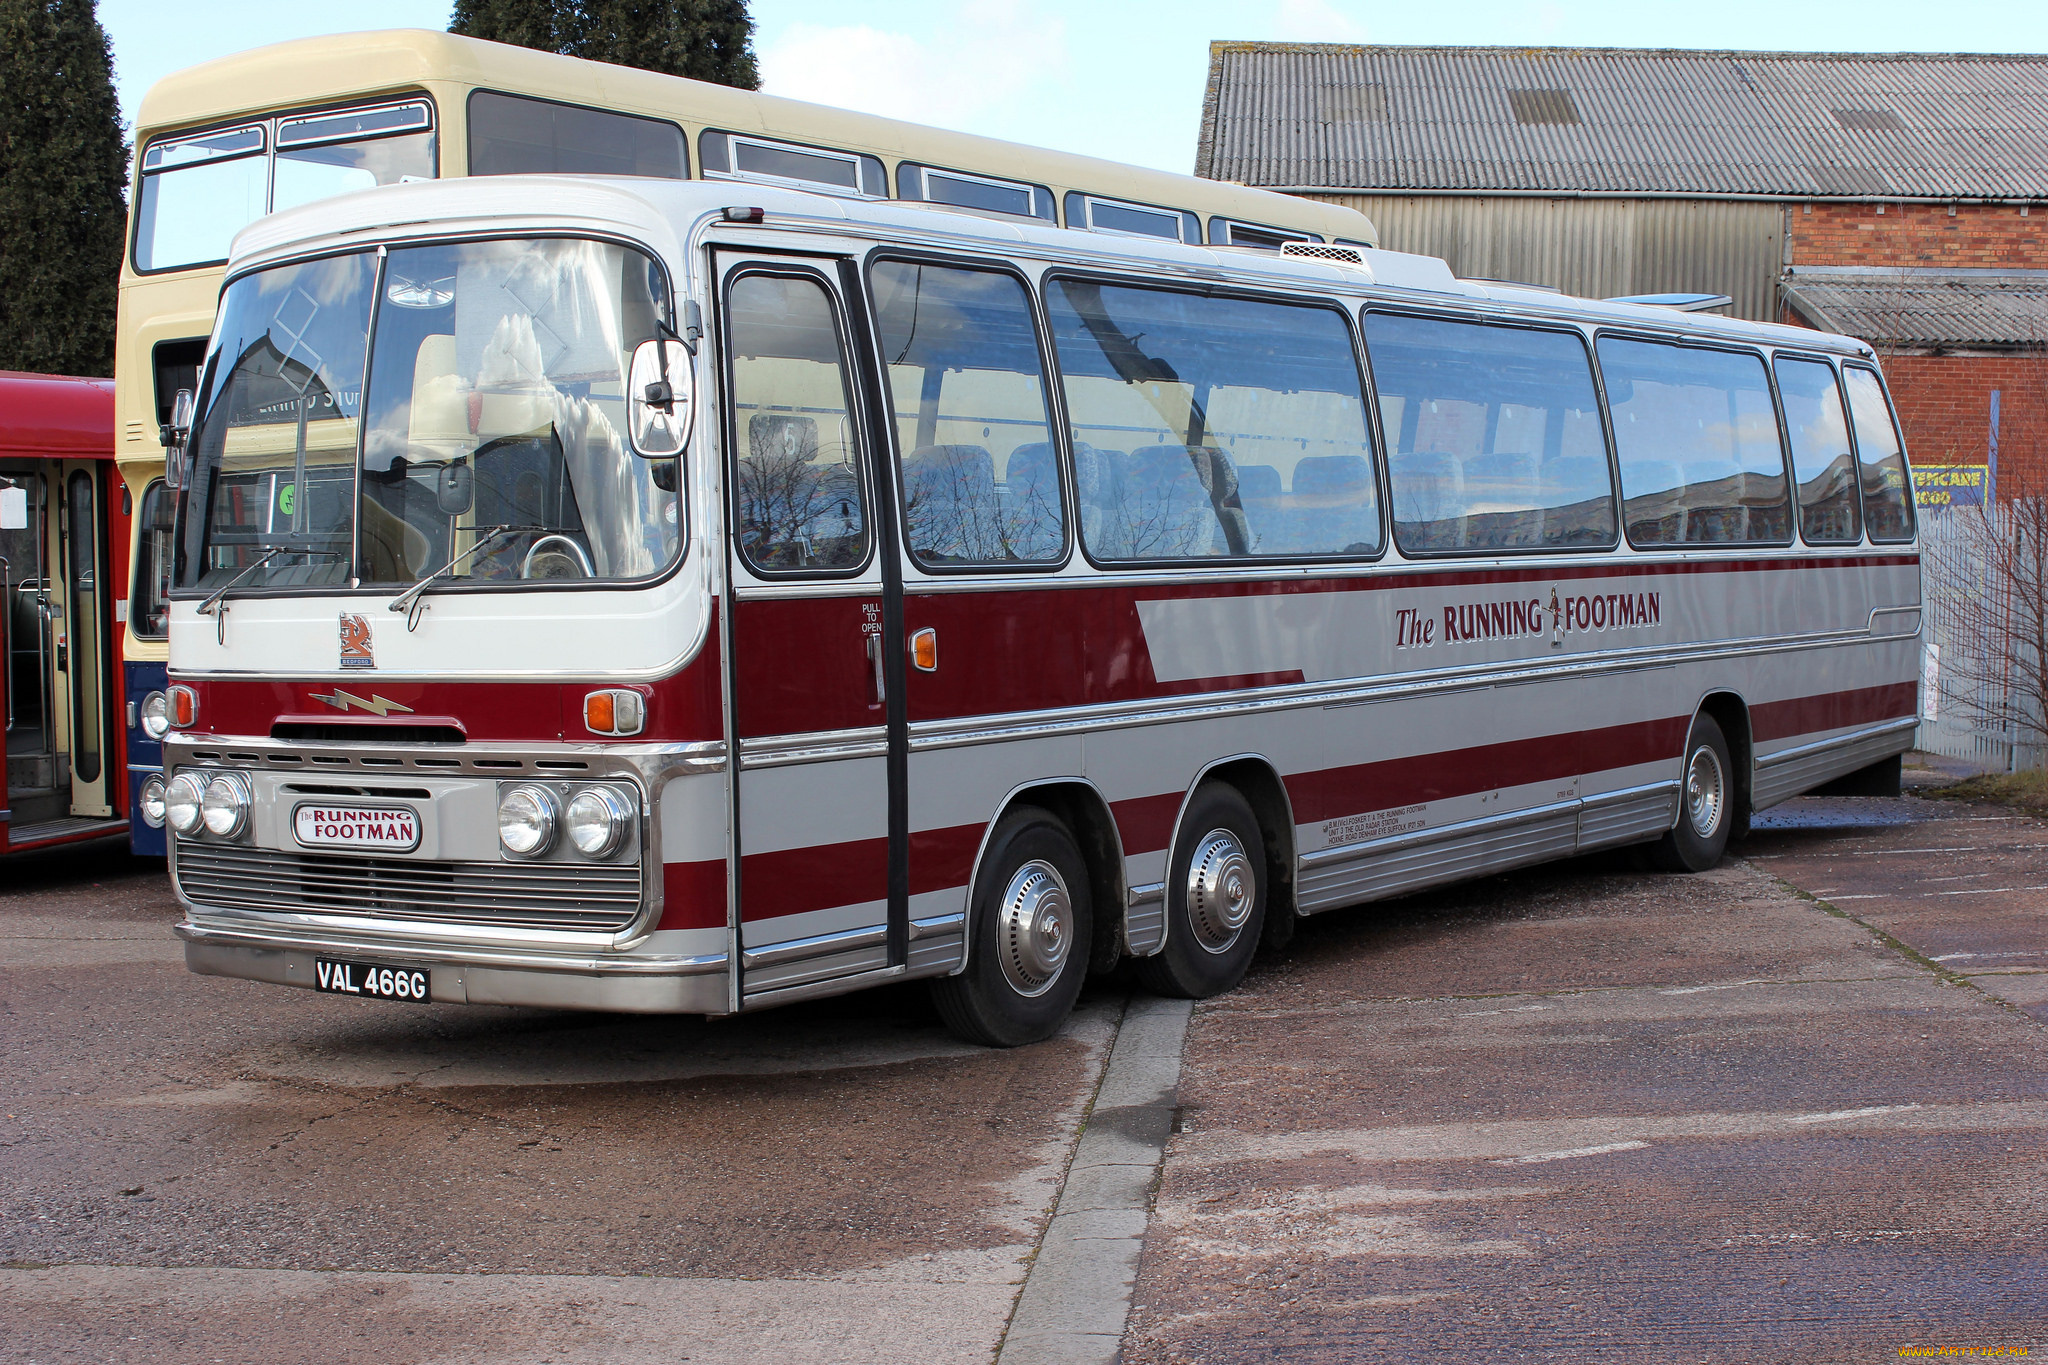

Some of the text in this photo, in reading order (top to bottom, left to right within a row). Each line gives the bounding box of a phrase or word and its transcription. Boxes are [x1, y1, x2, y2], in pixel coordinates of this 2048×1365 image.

[784, 423, 796, 455] 5
[862, 602, 881, 613] PULL
[866, 613, 877, 622] TO
[1396, 592, 1661, 648] The RUNNING FOOTMAN
[861, 622, 882, 632] OPEN
[300, 810, 411, 822] The RUNNING
[1387, 808, 1405, 817] RUNNING
[1407, 804, 1426, 814] FOOTMAN
[315, 823, 413, 840] FOOTMAN
[1329, 828, 1339, 837] UNIT
[1345, 825, 1354, 833] THE
[1355, 824, 1364, 832] OLD
[1366, 820, 1380, 829] RADAR
[1381, 817, 1398, 827] STATION
[1345, 832, 1357, 841] ROAD
[1359, 829, 1377, 839] DENHAM
[1378, 826, 1387, 835] EYE
[1387, 823, 1406, 834] SUFFOLK
[317, 961, 426, 999] VAL 466G
